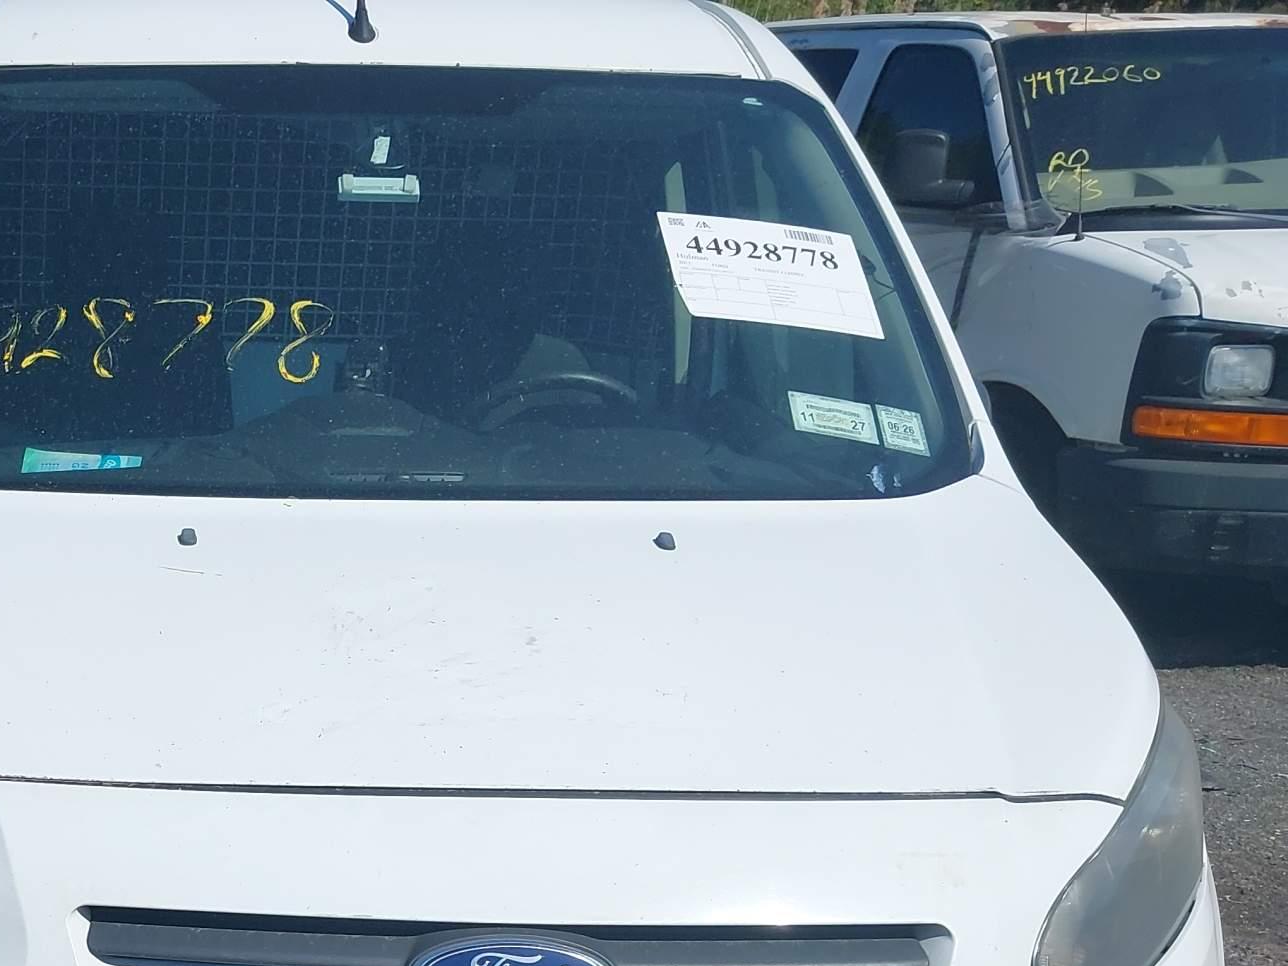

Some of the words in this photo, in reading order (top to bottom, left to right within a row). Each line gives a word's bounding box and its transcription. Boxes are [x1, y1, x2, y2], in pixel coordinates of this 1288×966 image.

[1024, 65, 1161, 99] 44922060
[686, 235, 839, 270] 44928778
[800, 411, 815, 423] 11
[850, 420, 866, 431] 27
